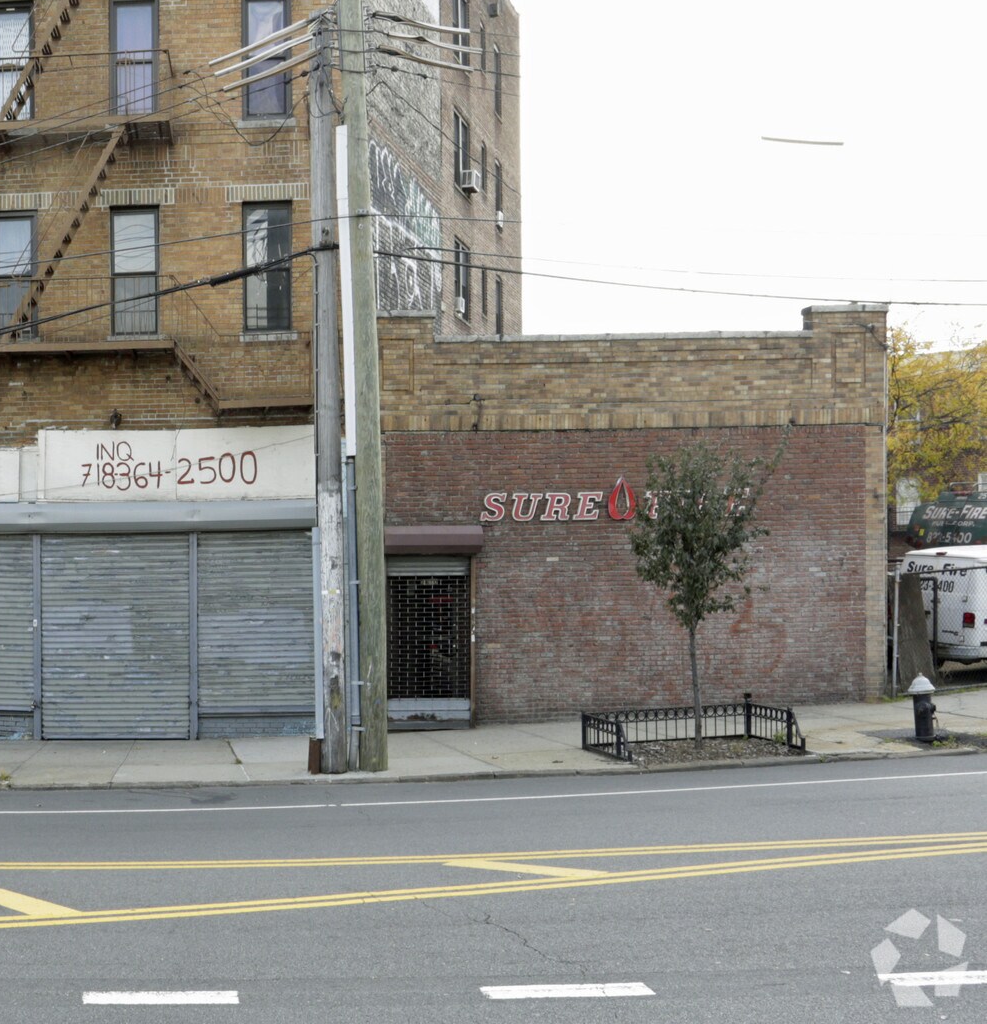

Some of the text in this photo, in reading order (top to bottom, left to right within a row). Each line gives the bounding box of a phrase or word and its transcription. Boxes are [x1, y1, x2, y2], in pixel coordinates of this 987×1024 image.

[96, 441, 134, 461] INQ
[480, 491, 603, 522] SURE
[907, 561, 968, 576] Sure Fire
